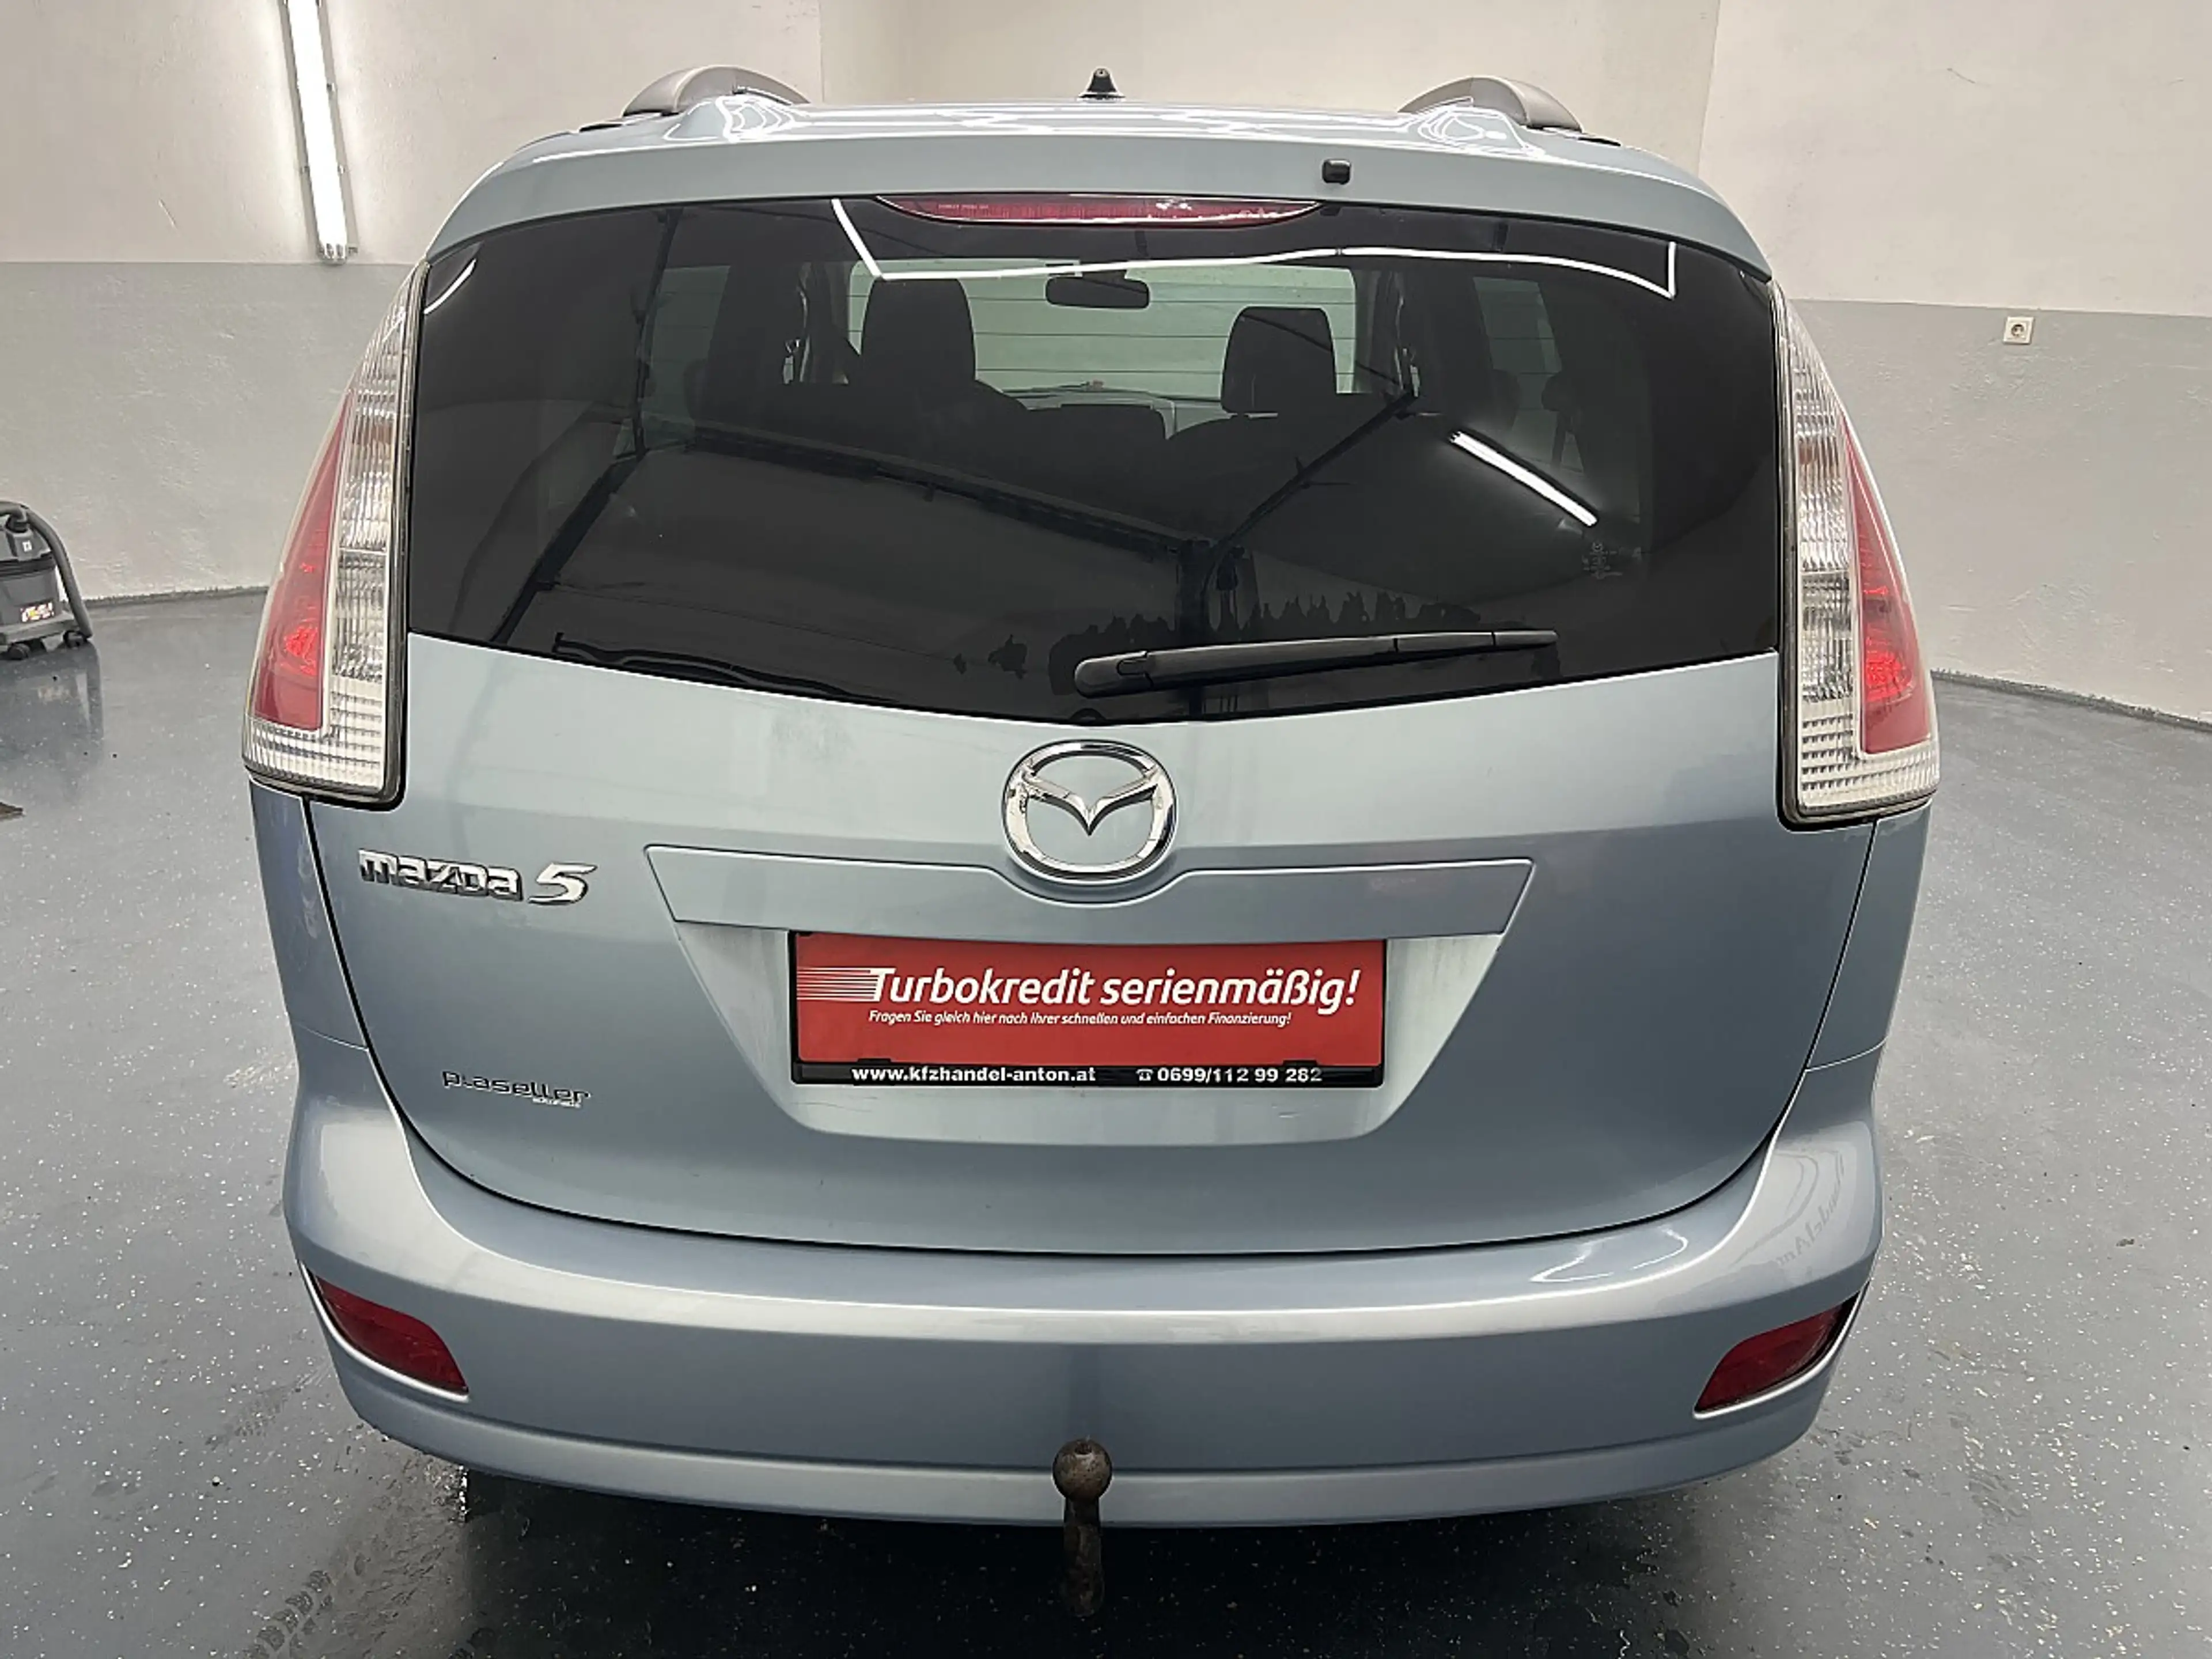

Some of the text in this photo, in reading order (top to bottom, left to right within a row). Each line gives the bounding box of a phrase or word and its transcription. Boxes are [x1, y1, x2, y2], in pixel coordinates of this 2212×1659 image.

[357, 849, 598, 905] mazda 5
[871, 967, 1362, 1016] Turbokredit serienmäßig!
[868, 1010, 912, 1026] Fragen
[914, 1011, 933, 1024] Sie
[934, 1011, 971, 1026] gleich
[972, 1012, 997, 1024] hier
[998, 1012, 1028, 1025] nach
[1060, 1013, 1118, 1025] schnellen
[1120, 1013, 1145, 1025] und
[1146, 1012, 1205, 1025] einfachen
[1206, 1012, 1293, 1028] Finanzierung!
[851, 1066, 1323, 1084] www.kfzhandel-anton.at 0699/112 99 282
